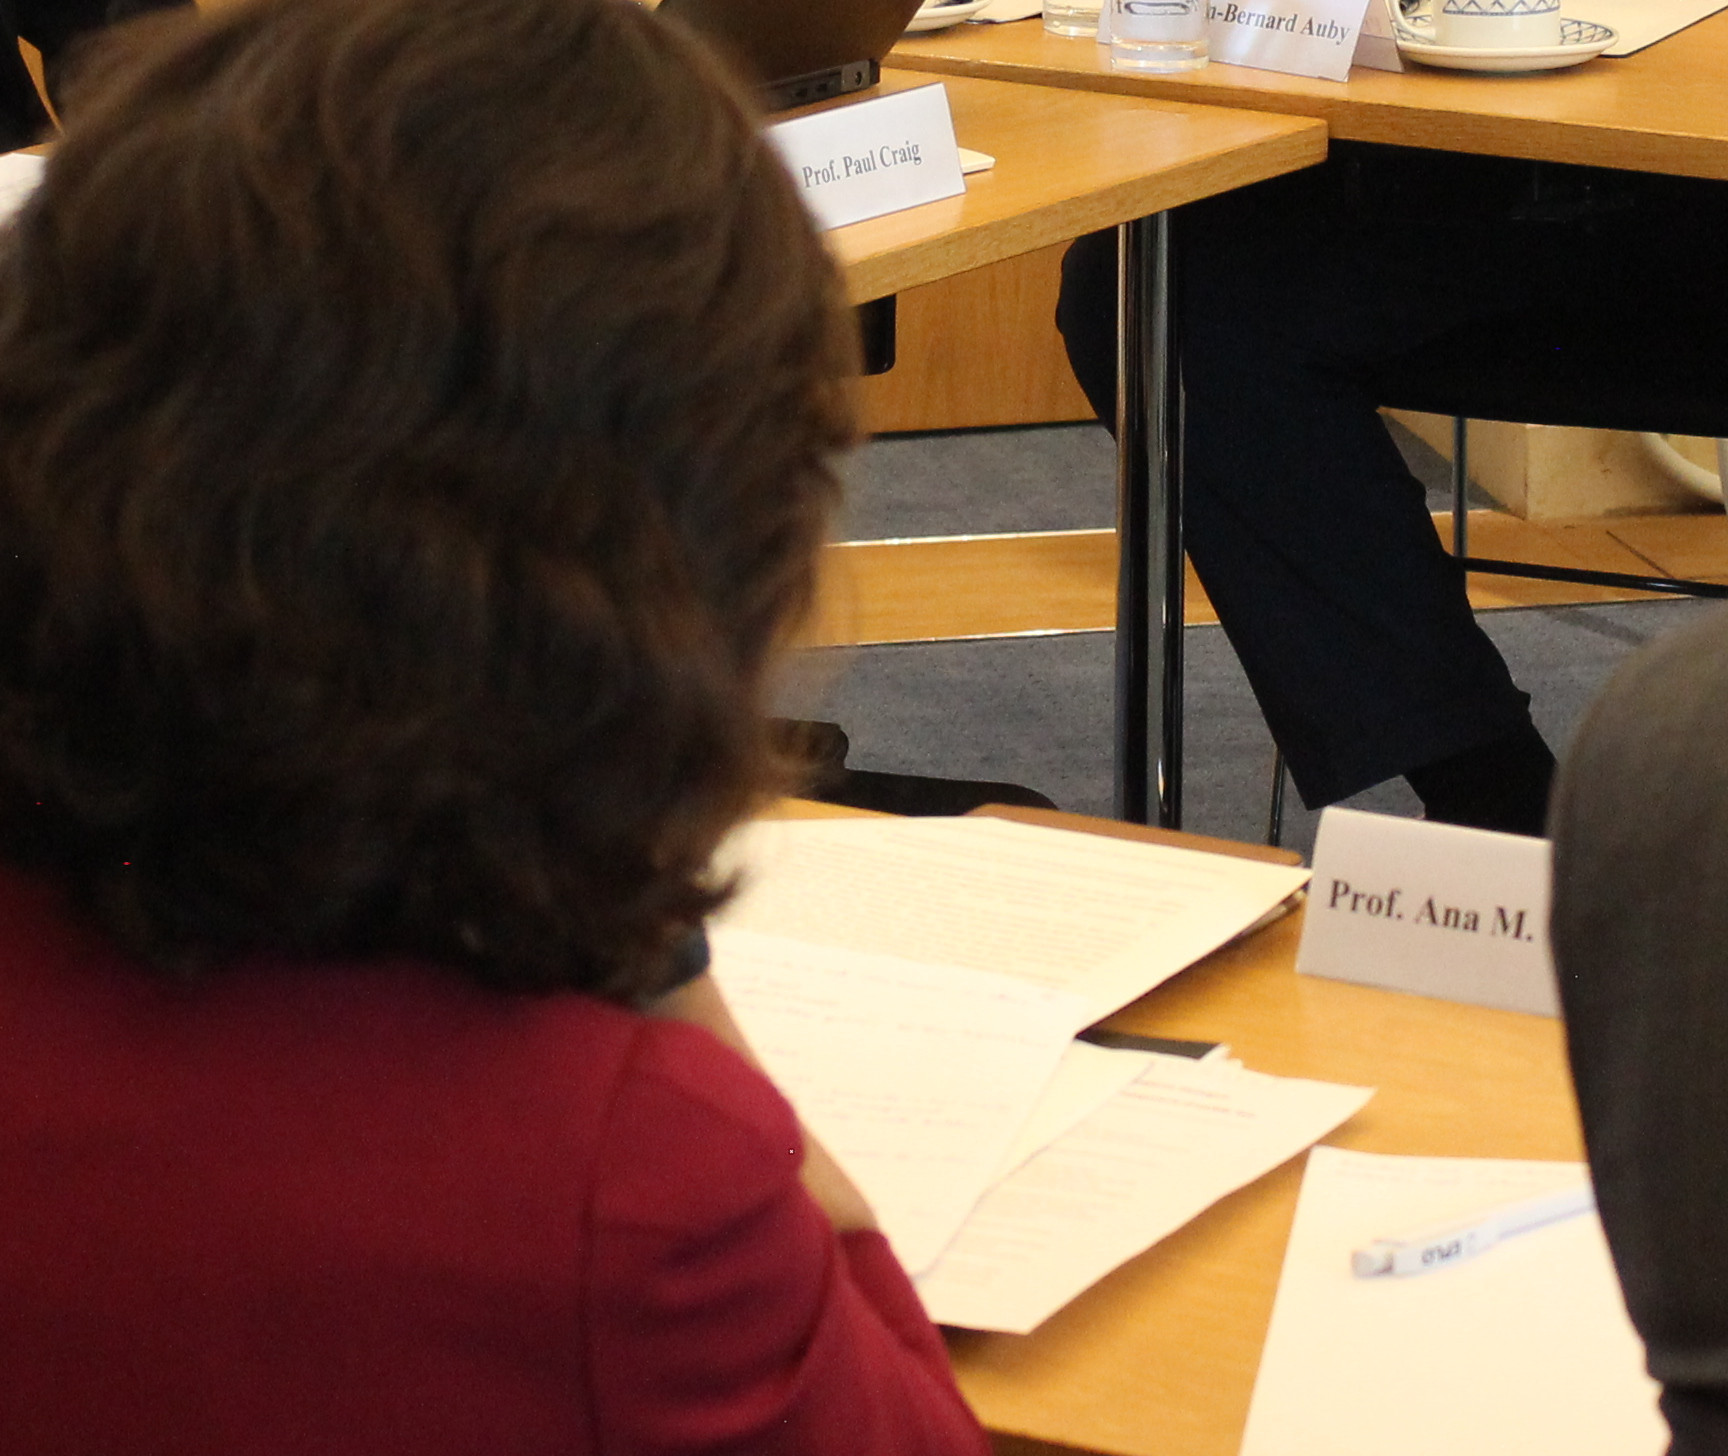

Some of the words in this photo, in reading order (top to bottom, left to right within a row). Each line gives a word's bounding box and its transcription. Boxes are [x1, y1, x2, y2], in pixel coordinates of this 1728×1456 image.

[1299, 12, 1351, 46] Auby
[802, 159, 842, 189] Prof.
[842, 149, 877, 178] Paul
[878, 140, 923, 166] Craig
[1328, 879, 1403, 921] Prof.
[1413, 895, 1479, 932] Ana
[1489, 906, 1534, 942] M.
